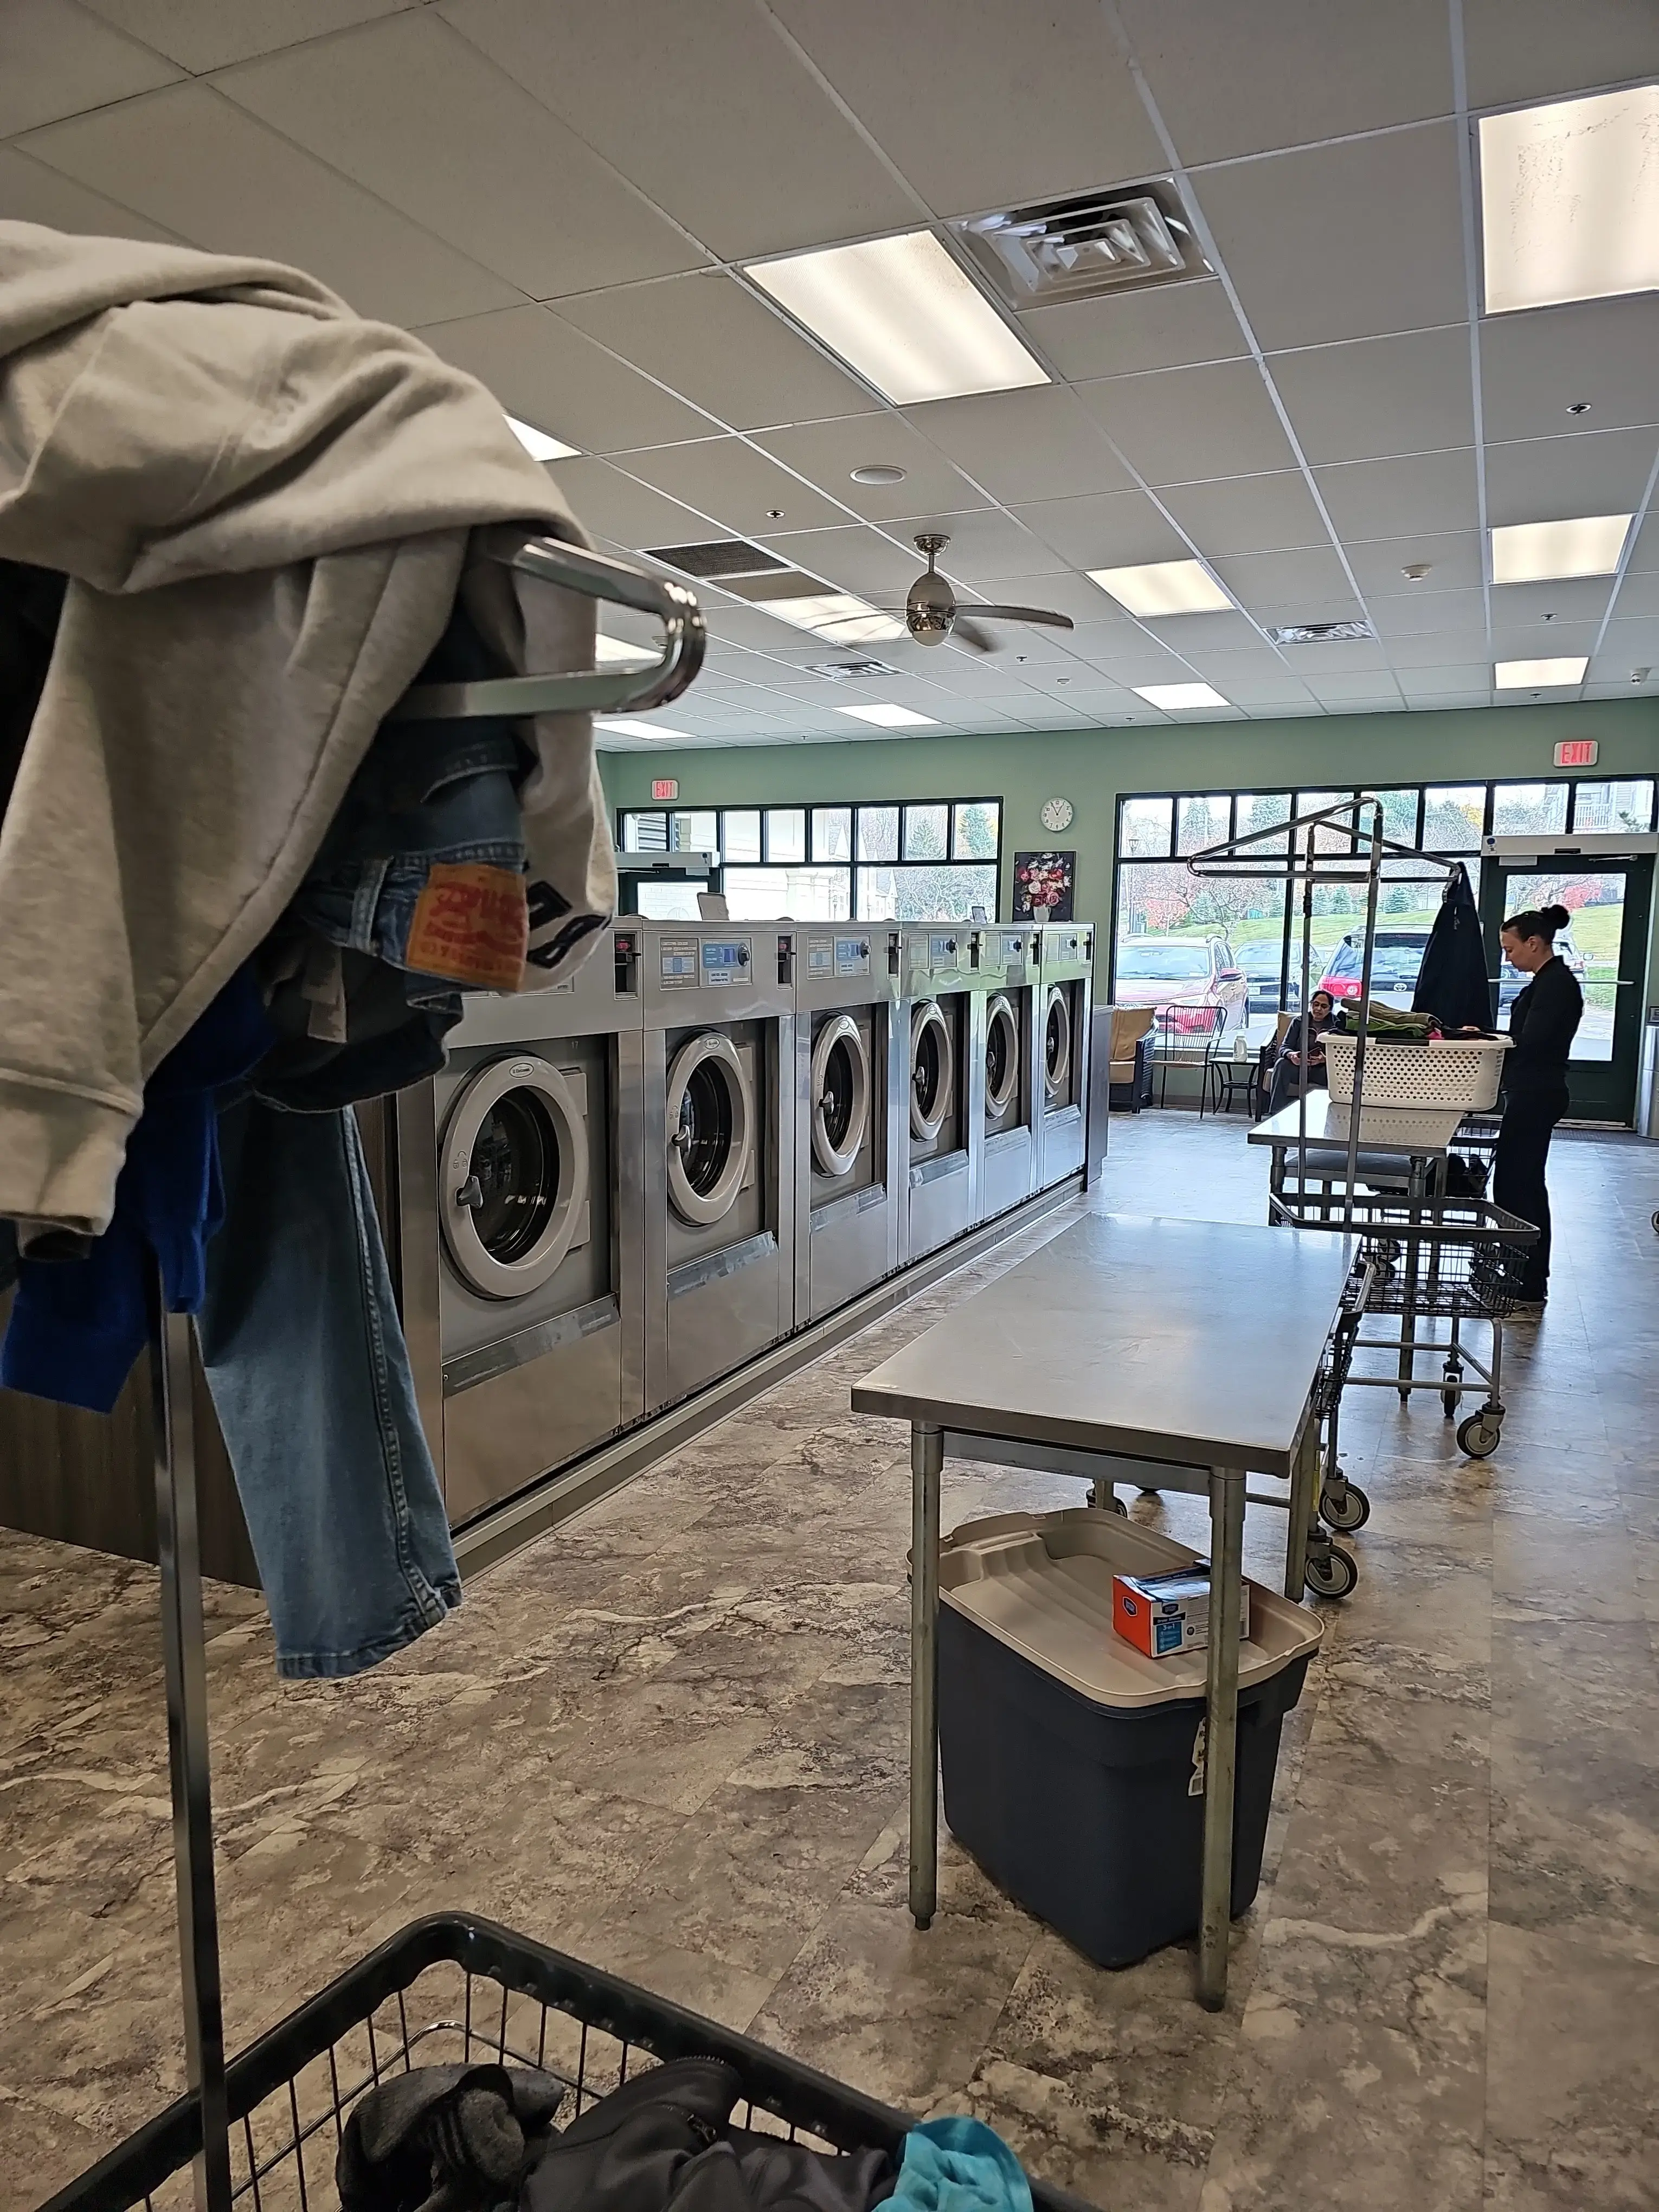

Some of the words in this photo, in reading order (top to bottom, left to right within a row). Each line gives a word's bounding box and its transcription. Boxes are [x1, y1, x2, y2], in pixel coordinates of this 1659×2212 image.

[1561, 742, 1592, 764] EXIT
[656, 781, 673, 798] EXIT
[571, 1041, 578, 1049] 17
